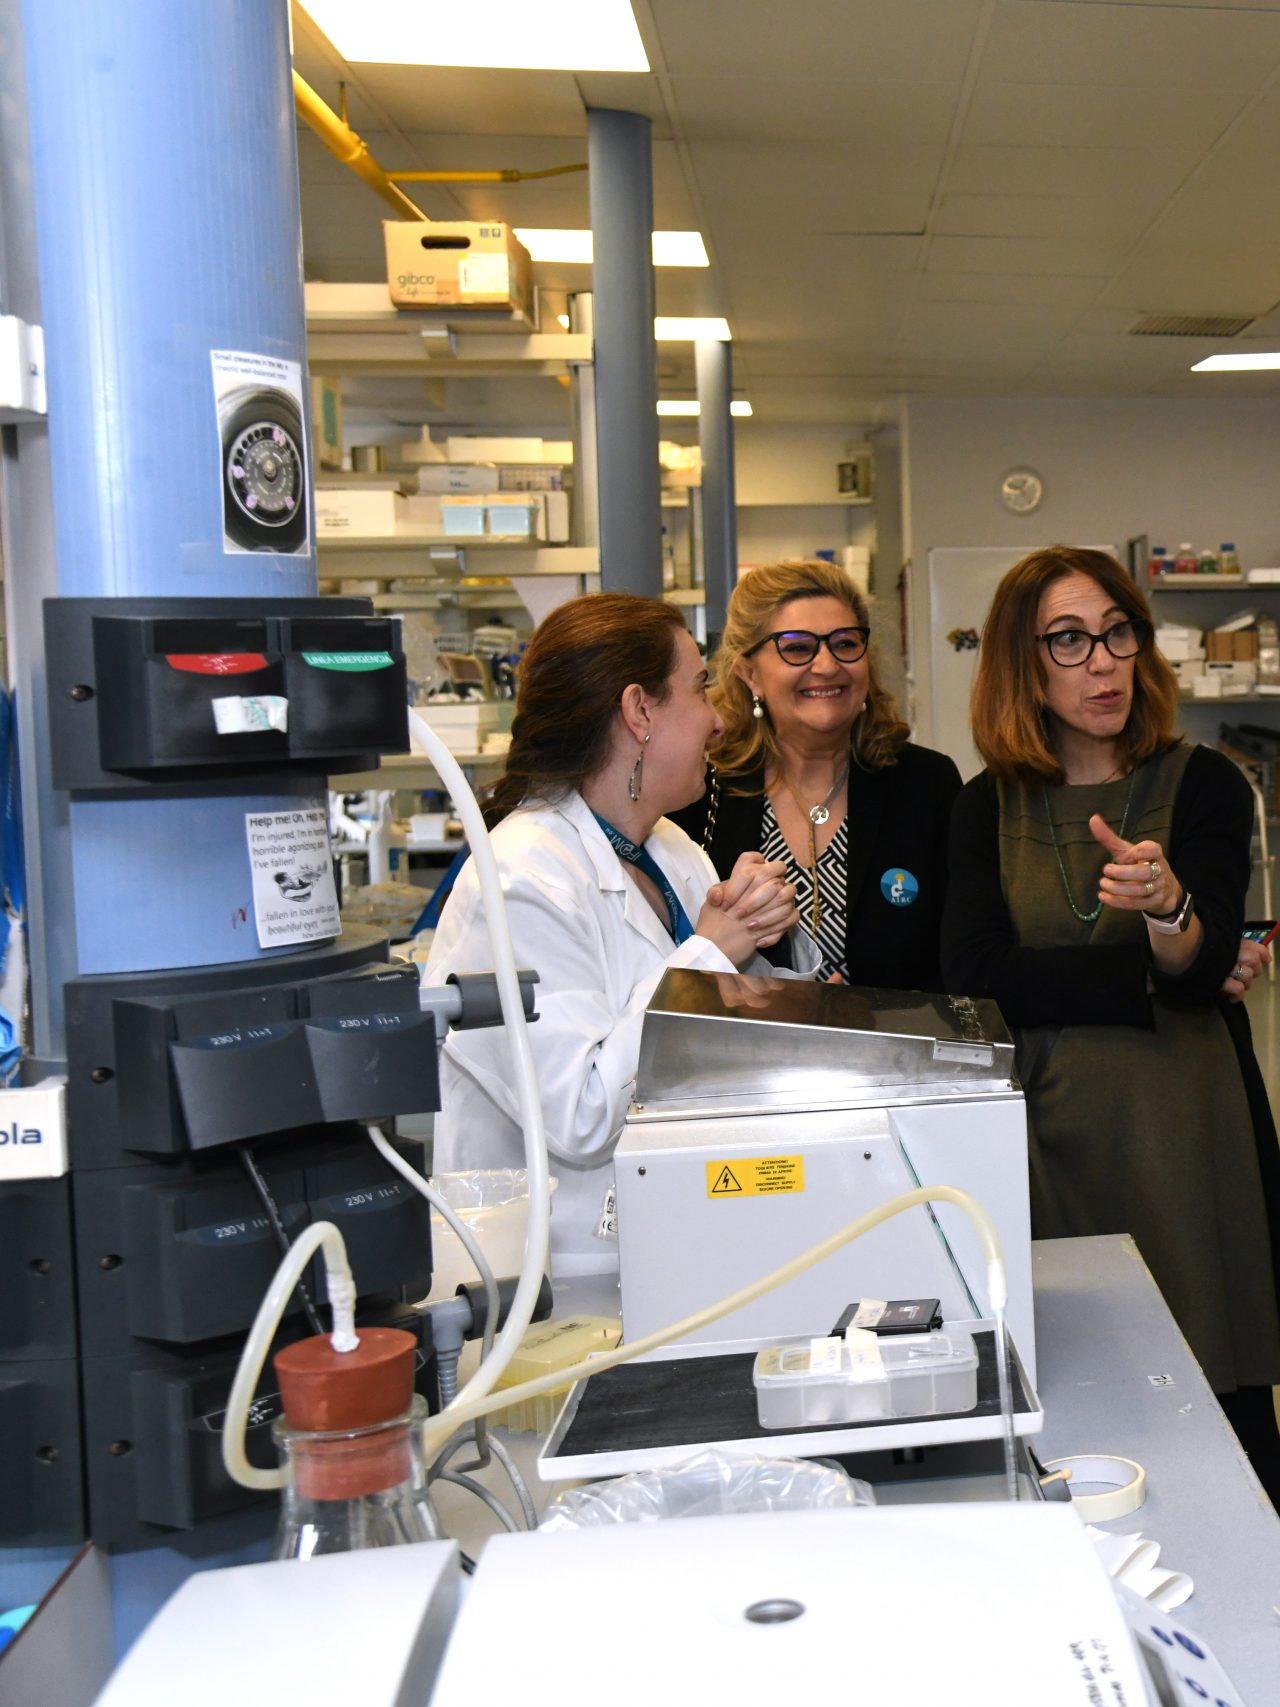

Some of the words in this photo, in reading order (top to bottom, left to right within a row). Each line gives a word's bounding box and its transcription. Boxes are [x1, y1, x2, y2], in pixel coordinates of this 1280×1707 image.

[398, 272, 435, 288] gibco
[249, 817, 273, 828] Help
[252, 833, 265, 843] I'm
[252, 844, 286, 856] horrible
[890, 896, 912, 904] AIRC
[339, 1018, 361, 1028] 230
[210, 1035, 233, 1047] 230
[345, 1194, 366, 1207] 230
[215, 1224, 237, 1239] 230
